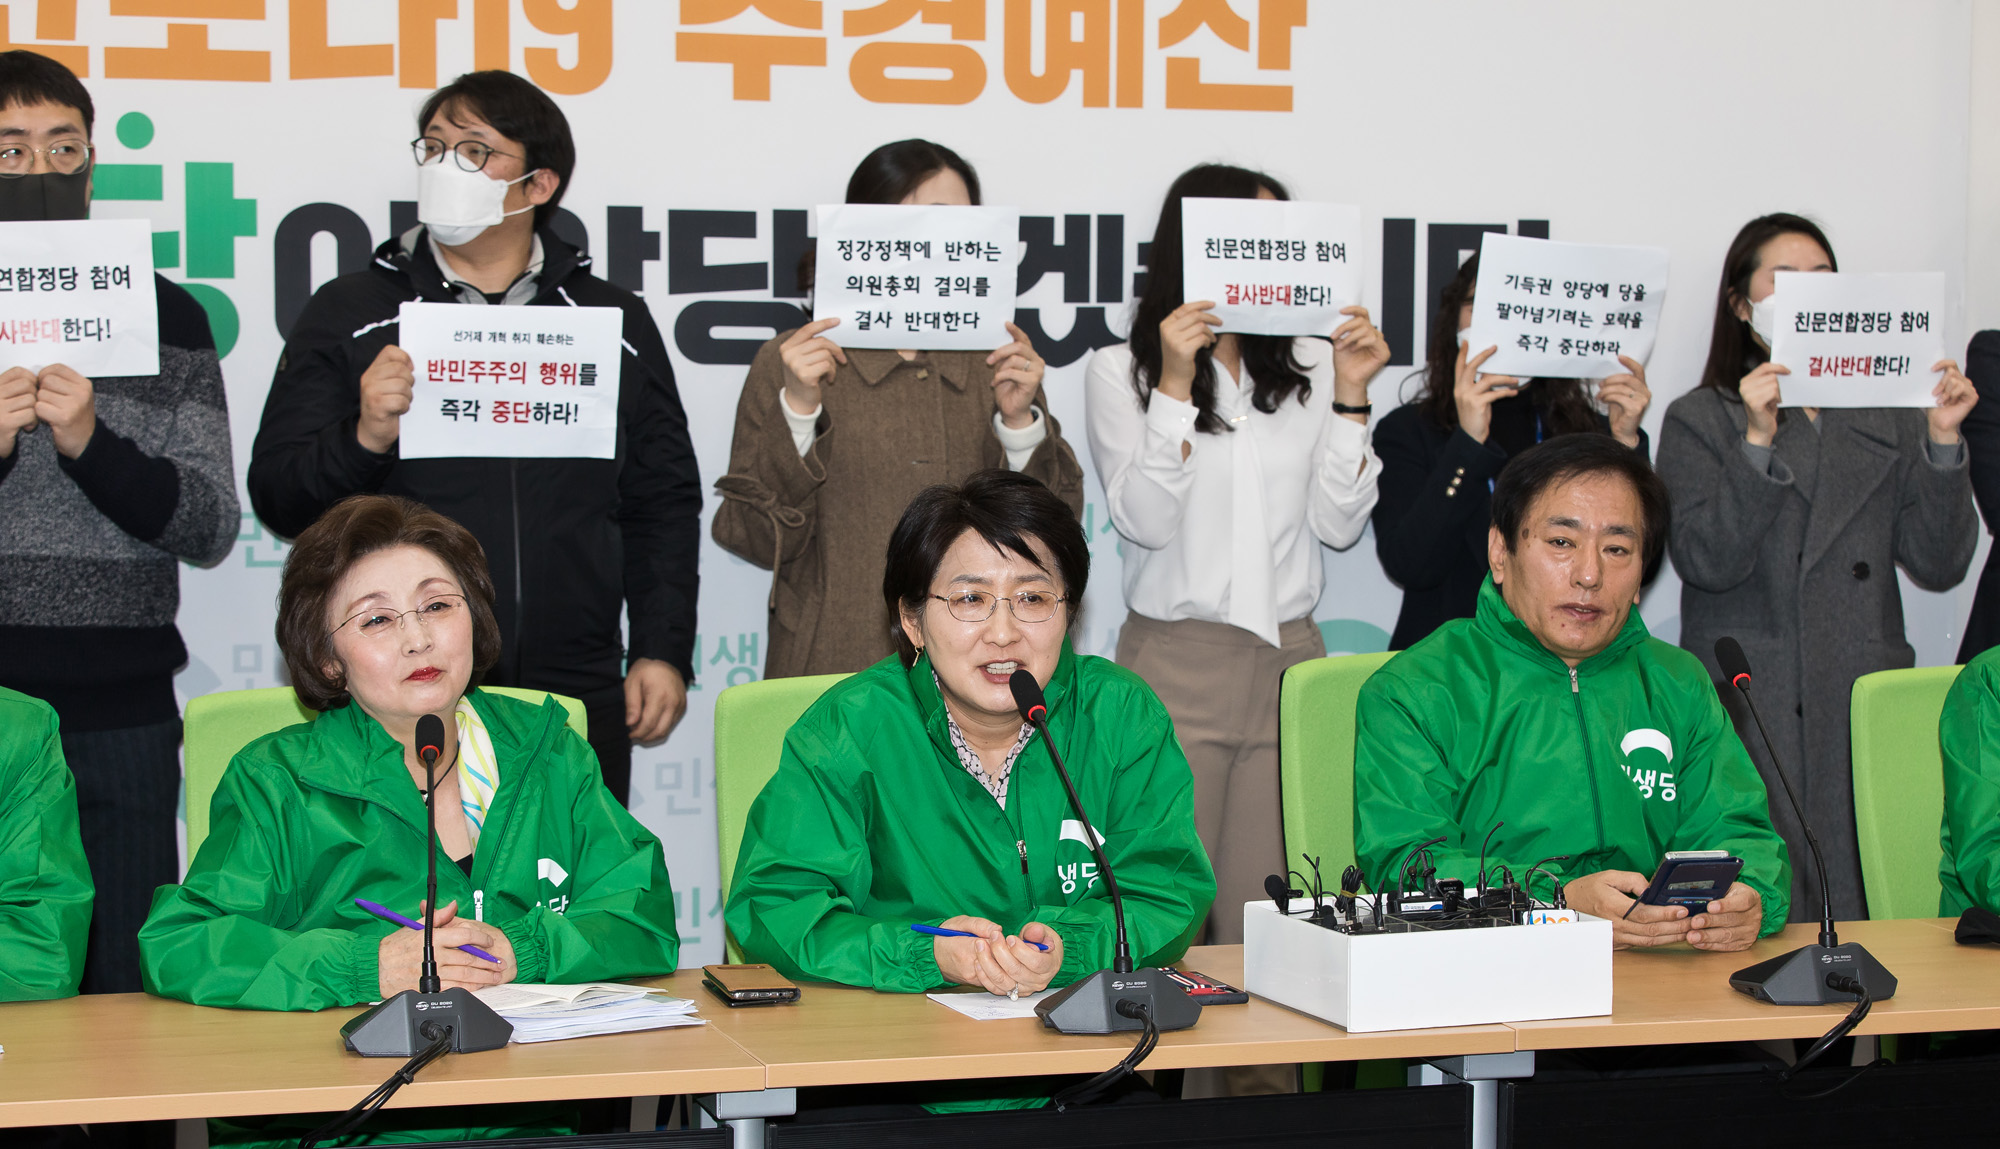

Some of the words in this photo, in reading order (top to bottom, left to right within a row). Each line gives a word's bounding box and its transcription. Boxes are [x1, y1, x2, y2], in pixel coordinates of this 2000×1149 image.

[838, 240, 930, 261] 정강정책에
[946, 241, 1001, 262] 반하는
[1206, 238, 1306, 261] 친문연합정당
[1316, 242, 1346, 263] 참여
[91, 265, 130, 290] 참여
[846, 275, 919, 297] 의원총회
[935, 277, 990, 297] 결의를
[1505, 275, 1552, 296] 기득권
[1563, 281, 1609, 300] 양당에
[1619, 284, 1646, 302] 당을
[1226, 284, 1330, 307] 결사반대한다!
[856, 311, 892, 330] 결사
[905, 312, 979, 332] 반대한다
[1497, 303, 1593, 328] 팔아넘기려는
[1603, 312, 1642, 329] 모략을
[1795, 312, 1892, 333] 친문연합정당
[1901, 311, 1929, 332] 참여
[454, 331, 482, 342] 선거제
[489, 332, 506, 343] 개혁
[513, 332, 530, 344] 취지
[537, 333, 573, 345] 훼손하는
[1517, 334, 1548, 352] 즉각
[1559, 338, 1620, 356] 중단하라
[428, 359, 526, 384] 반민주주의
[540, 362, 597, 386] 행위를
[1809, 356, 1910, 377] 결사반대한다!
[441, 399, 480, 422] 즉각
[492, 401, 578, 425] 중단하라!
